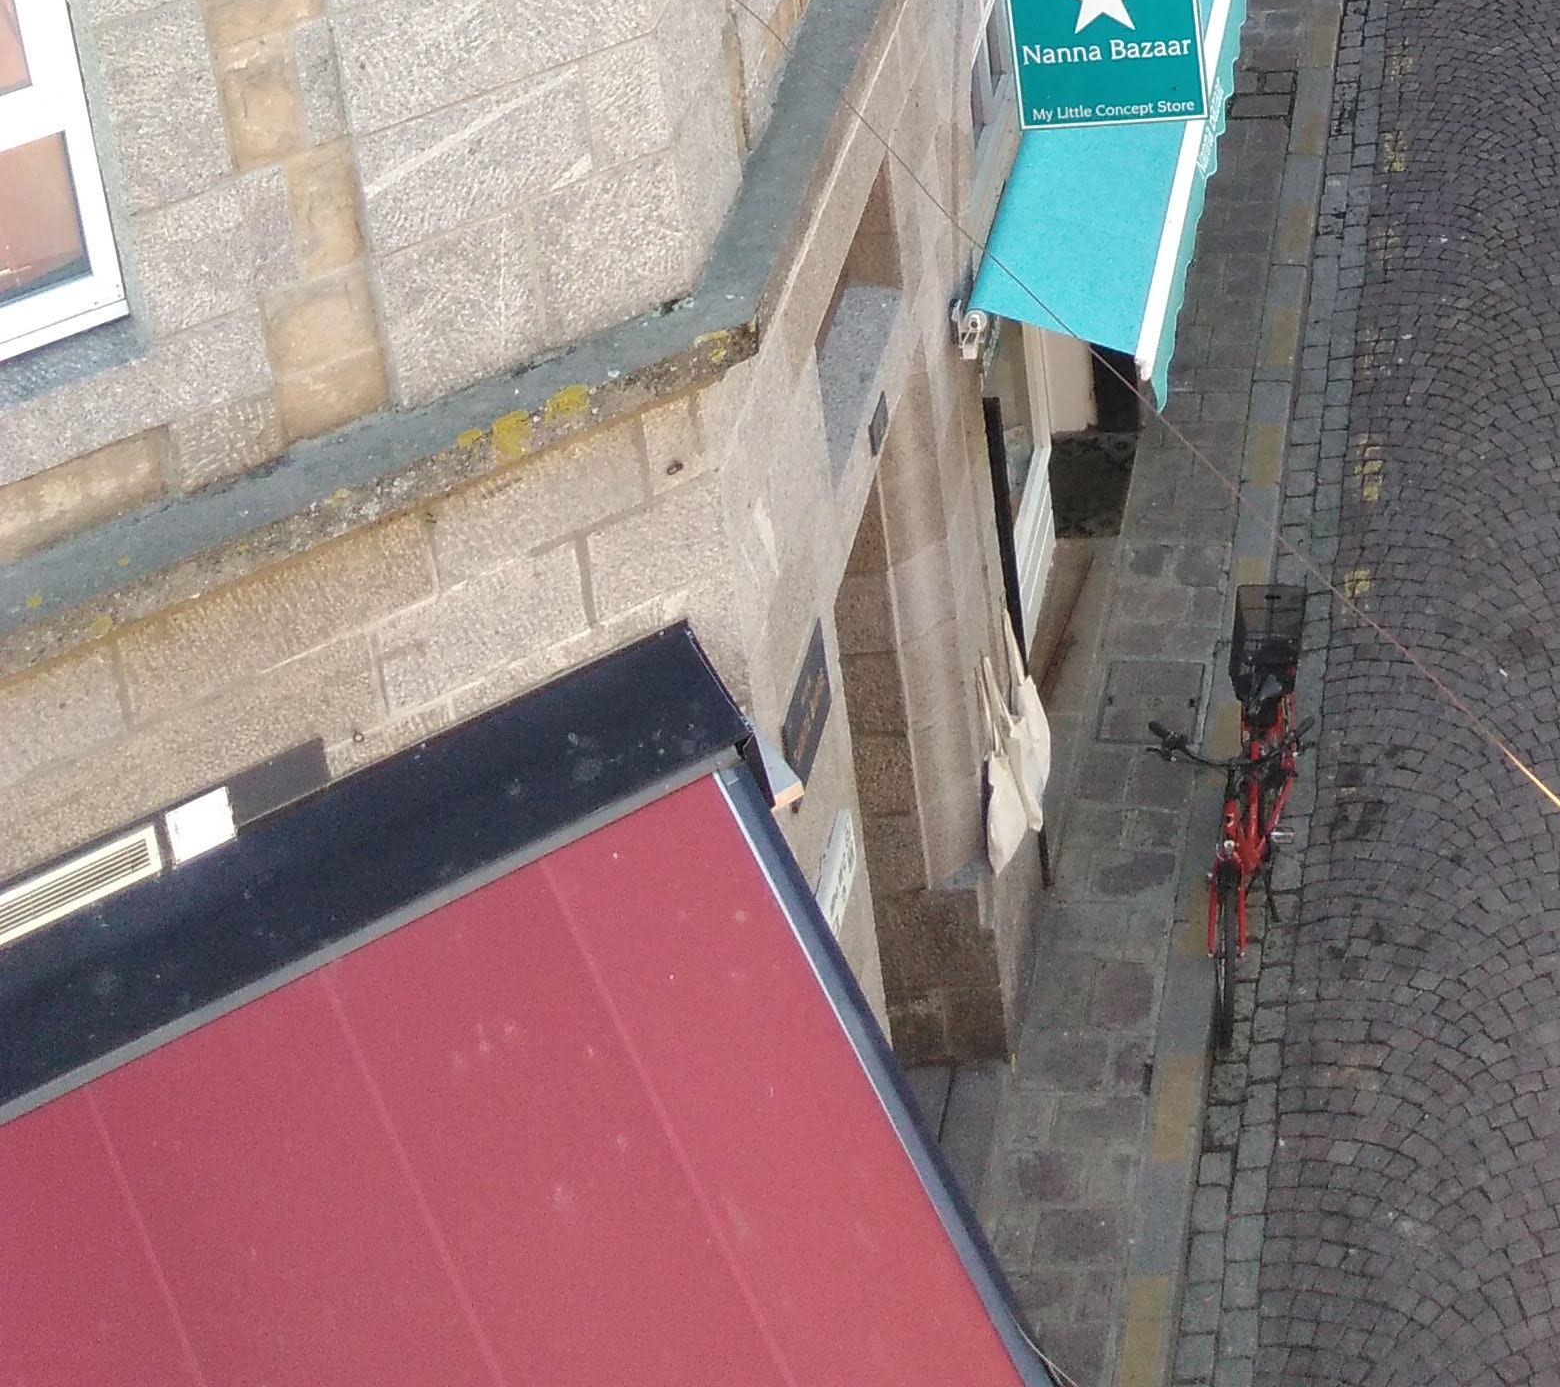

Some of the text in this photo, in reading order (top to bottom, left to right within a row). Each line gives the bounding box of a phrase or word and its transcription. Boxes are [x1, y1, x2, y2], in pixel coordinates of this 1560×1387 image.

[1022, 38, 1191, 66] Nanna Bazaar
[1032, 100, 1195, 122] My Little Concept Store
